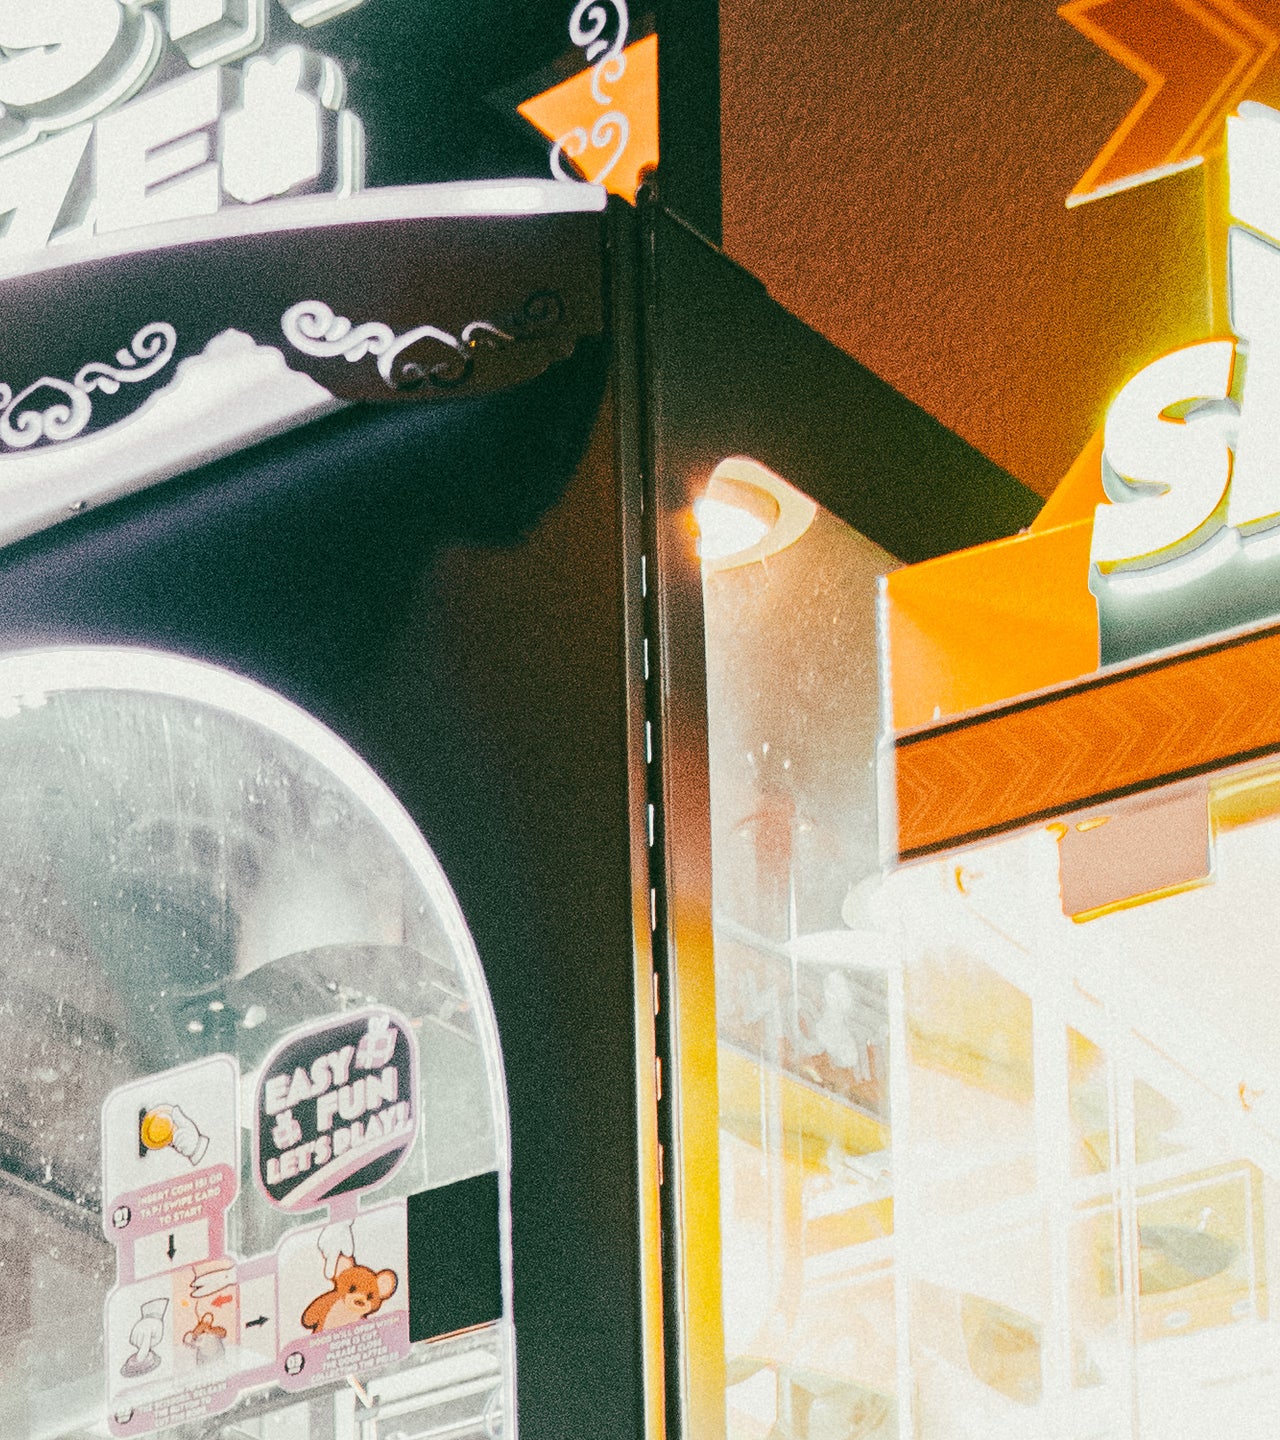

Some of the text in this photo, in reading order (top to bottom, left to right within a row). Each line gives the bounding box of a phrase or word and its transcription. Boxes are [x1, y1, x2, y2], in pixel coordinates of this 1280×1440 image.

[265, 1044, 355, 1116] EASY
[317, 1066, 399, 1132] FUN
[266, 1135, 332, 1186] LET'S
